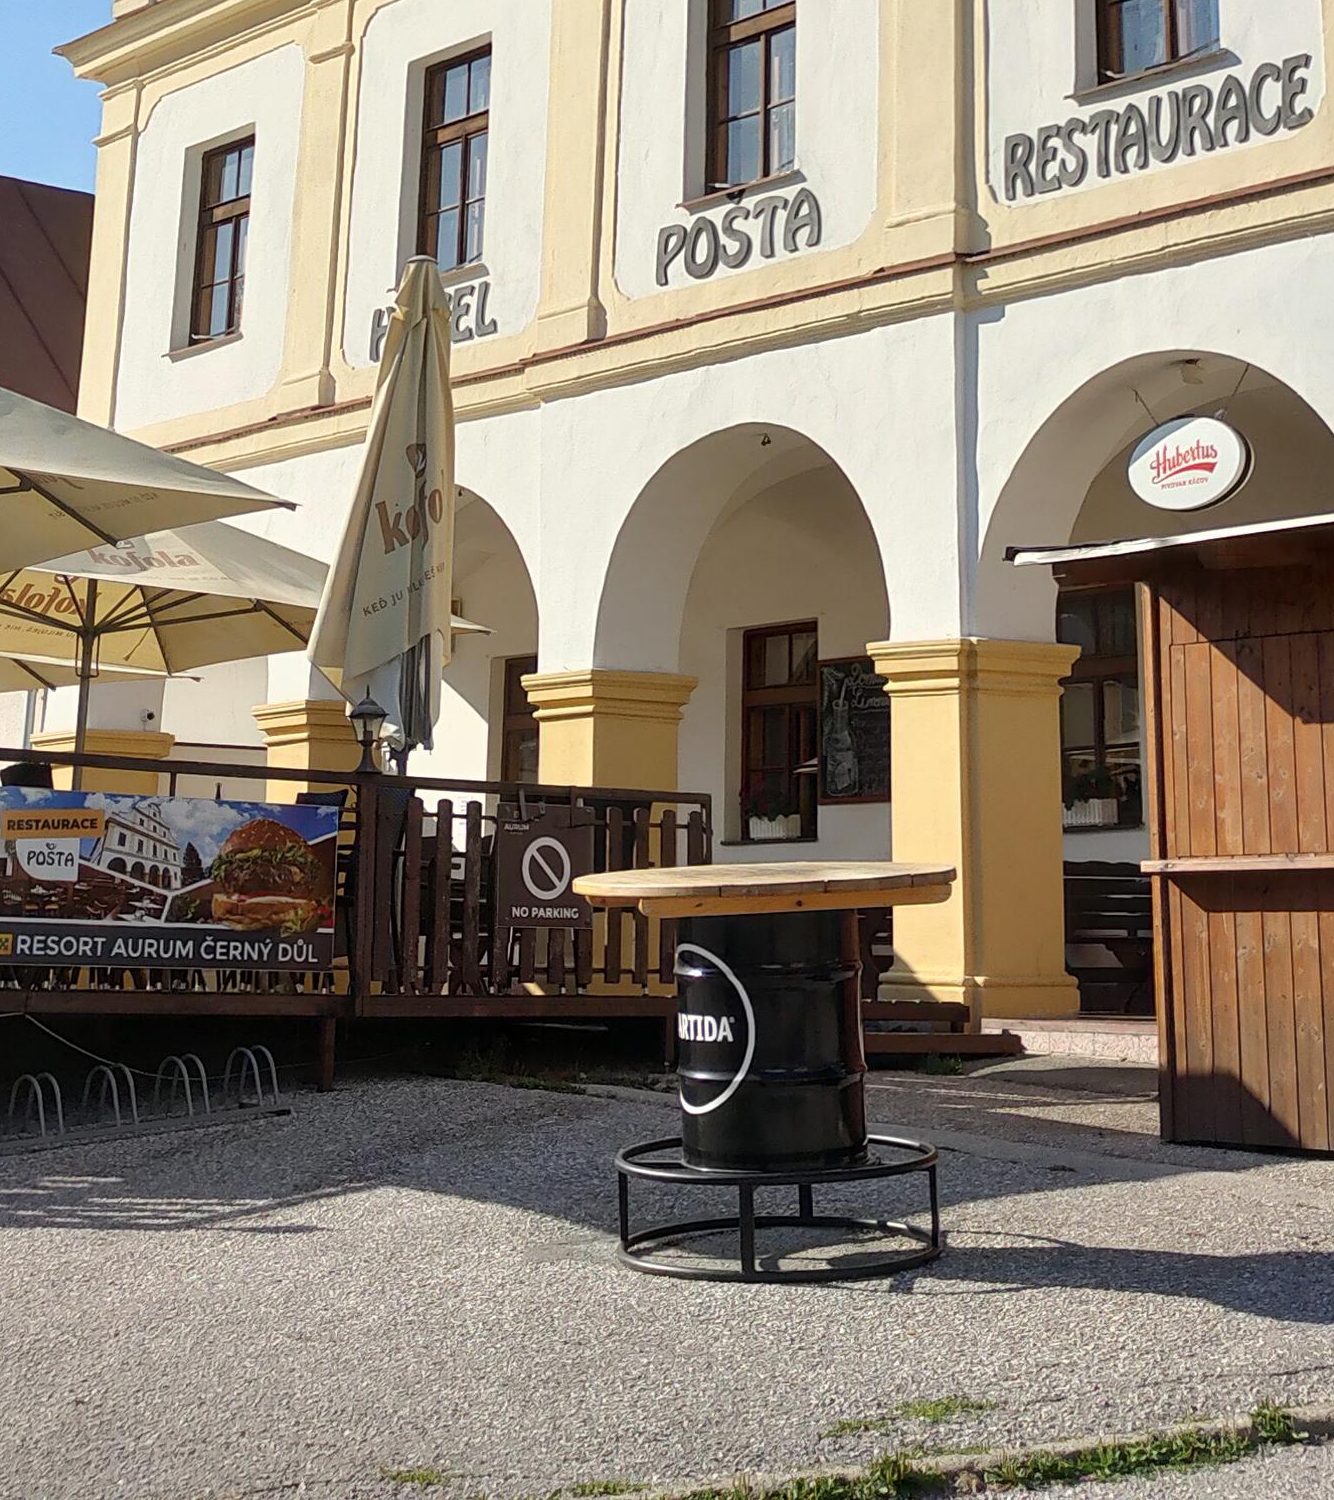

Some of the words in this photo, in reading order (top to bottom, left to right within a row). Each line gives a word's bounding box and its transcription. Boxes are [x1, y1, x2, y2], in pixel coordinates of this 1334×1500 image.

[1004, 54, 1314, 201] RESTAURACE
[656, 187, 822, 287] POŠTA
[369, 281, 498, 362] HEL
[1150, 438, 1218, 480] Hubertus
[88, 548, 201, 572] kofola
[362, 596, 387, 617] KEĎ
[391, 590, 403, 607] JU
[6, 818, 98, 831] RESTAURACE
[511, 906, 529, 918] NO
[531, 907, 579, 919] PARKING
[17, 935, 107, 957] RESORT
[110, 937, 193, 959] AURUM
[200, 936, 273, 961] ČERNÝ
[278, 938, 318, 963] DŮL
